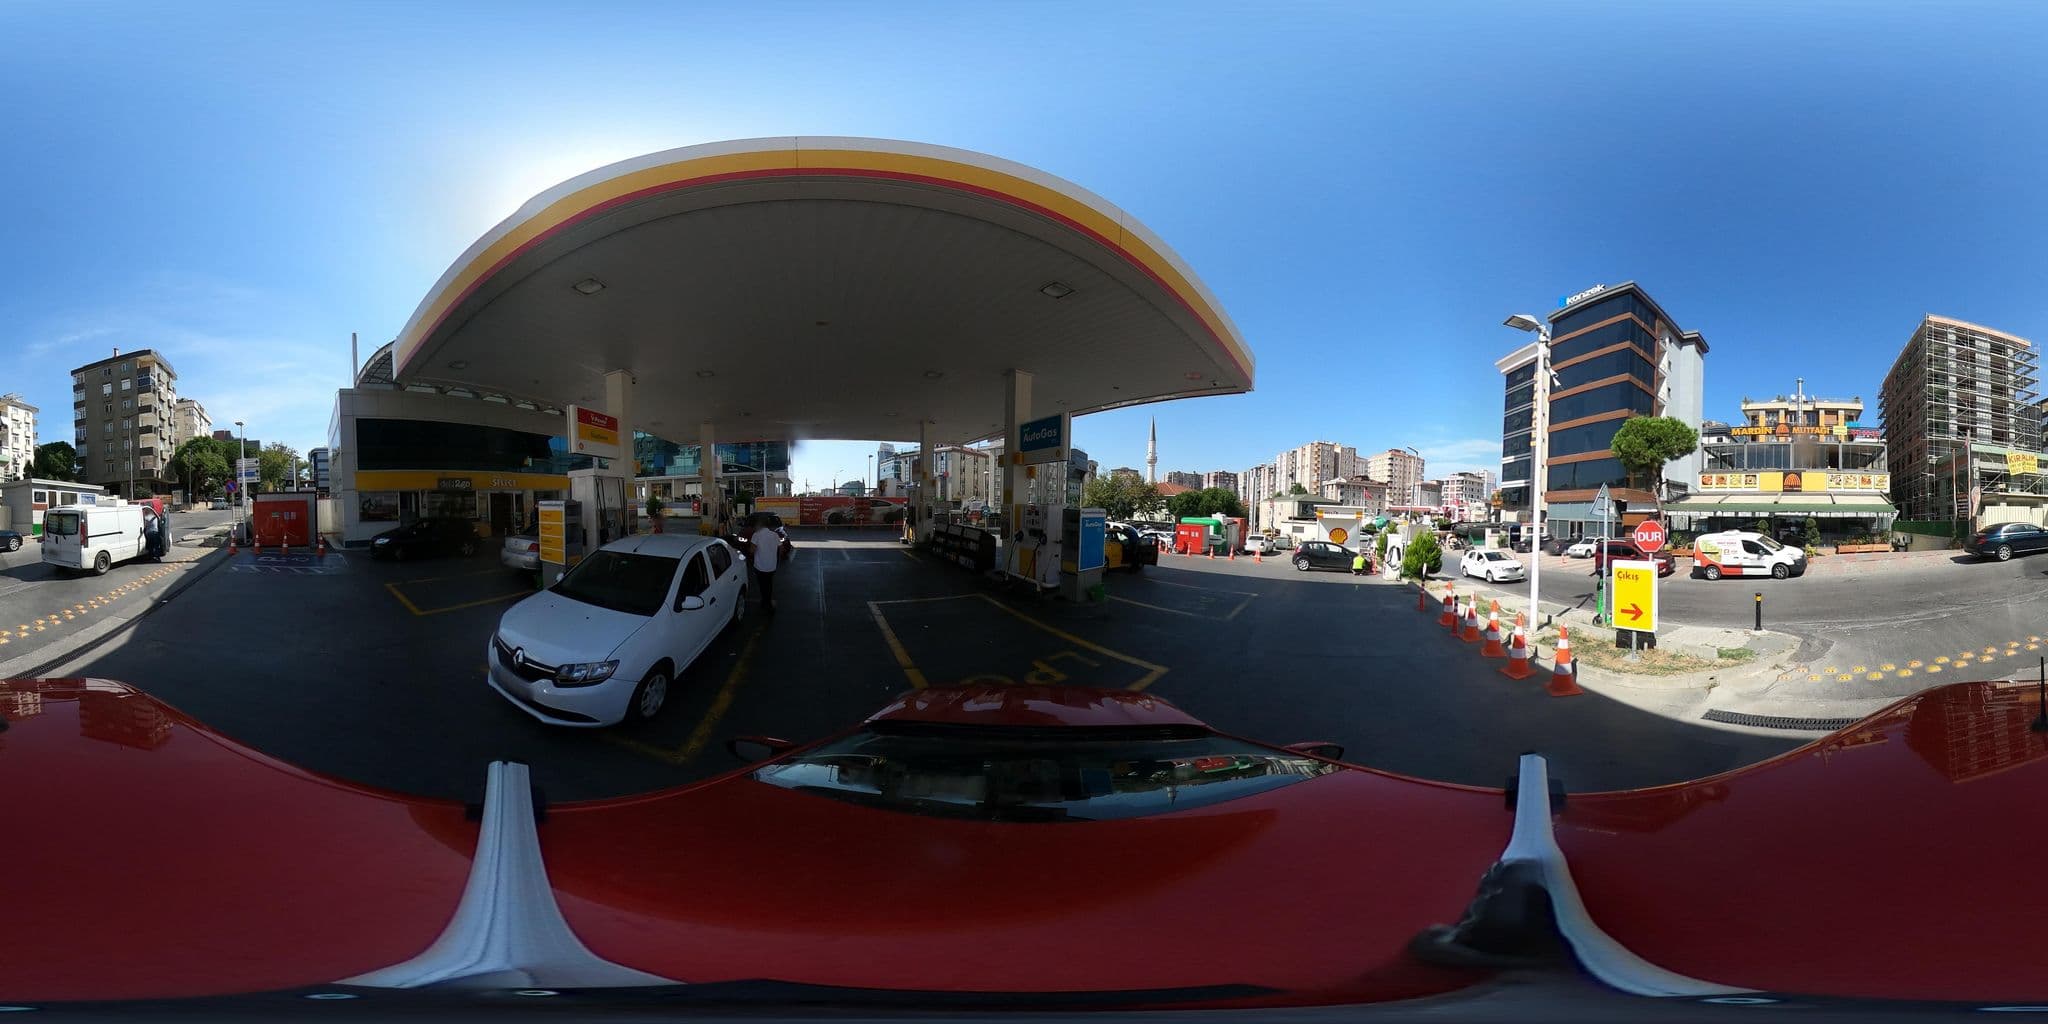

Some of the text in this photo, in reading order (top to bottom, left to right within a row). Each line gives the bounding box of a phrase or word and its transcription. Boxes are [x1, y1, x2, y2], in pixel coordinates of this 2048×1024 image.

[1566, 284, 1606, 305] konzek
[1023, 427, 1057, 443] AutoGas
[1637, 531, 1662, 542] DUR
[1617, 570, 1640, 582] Çıkış
